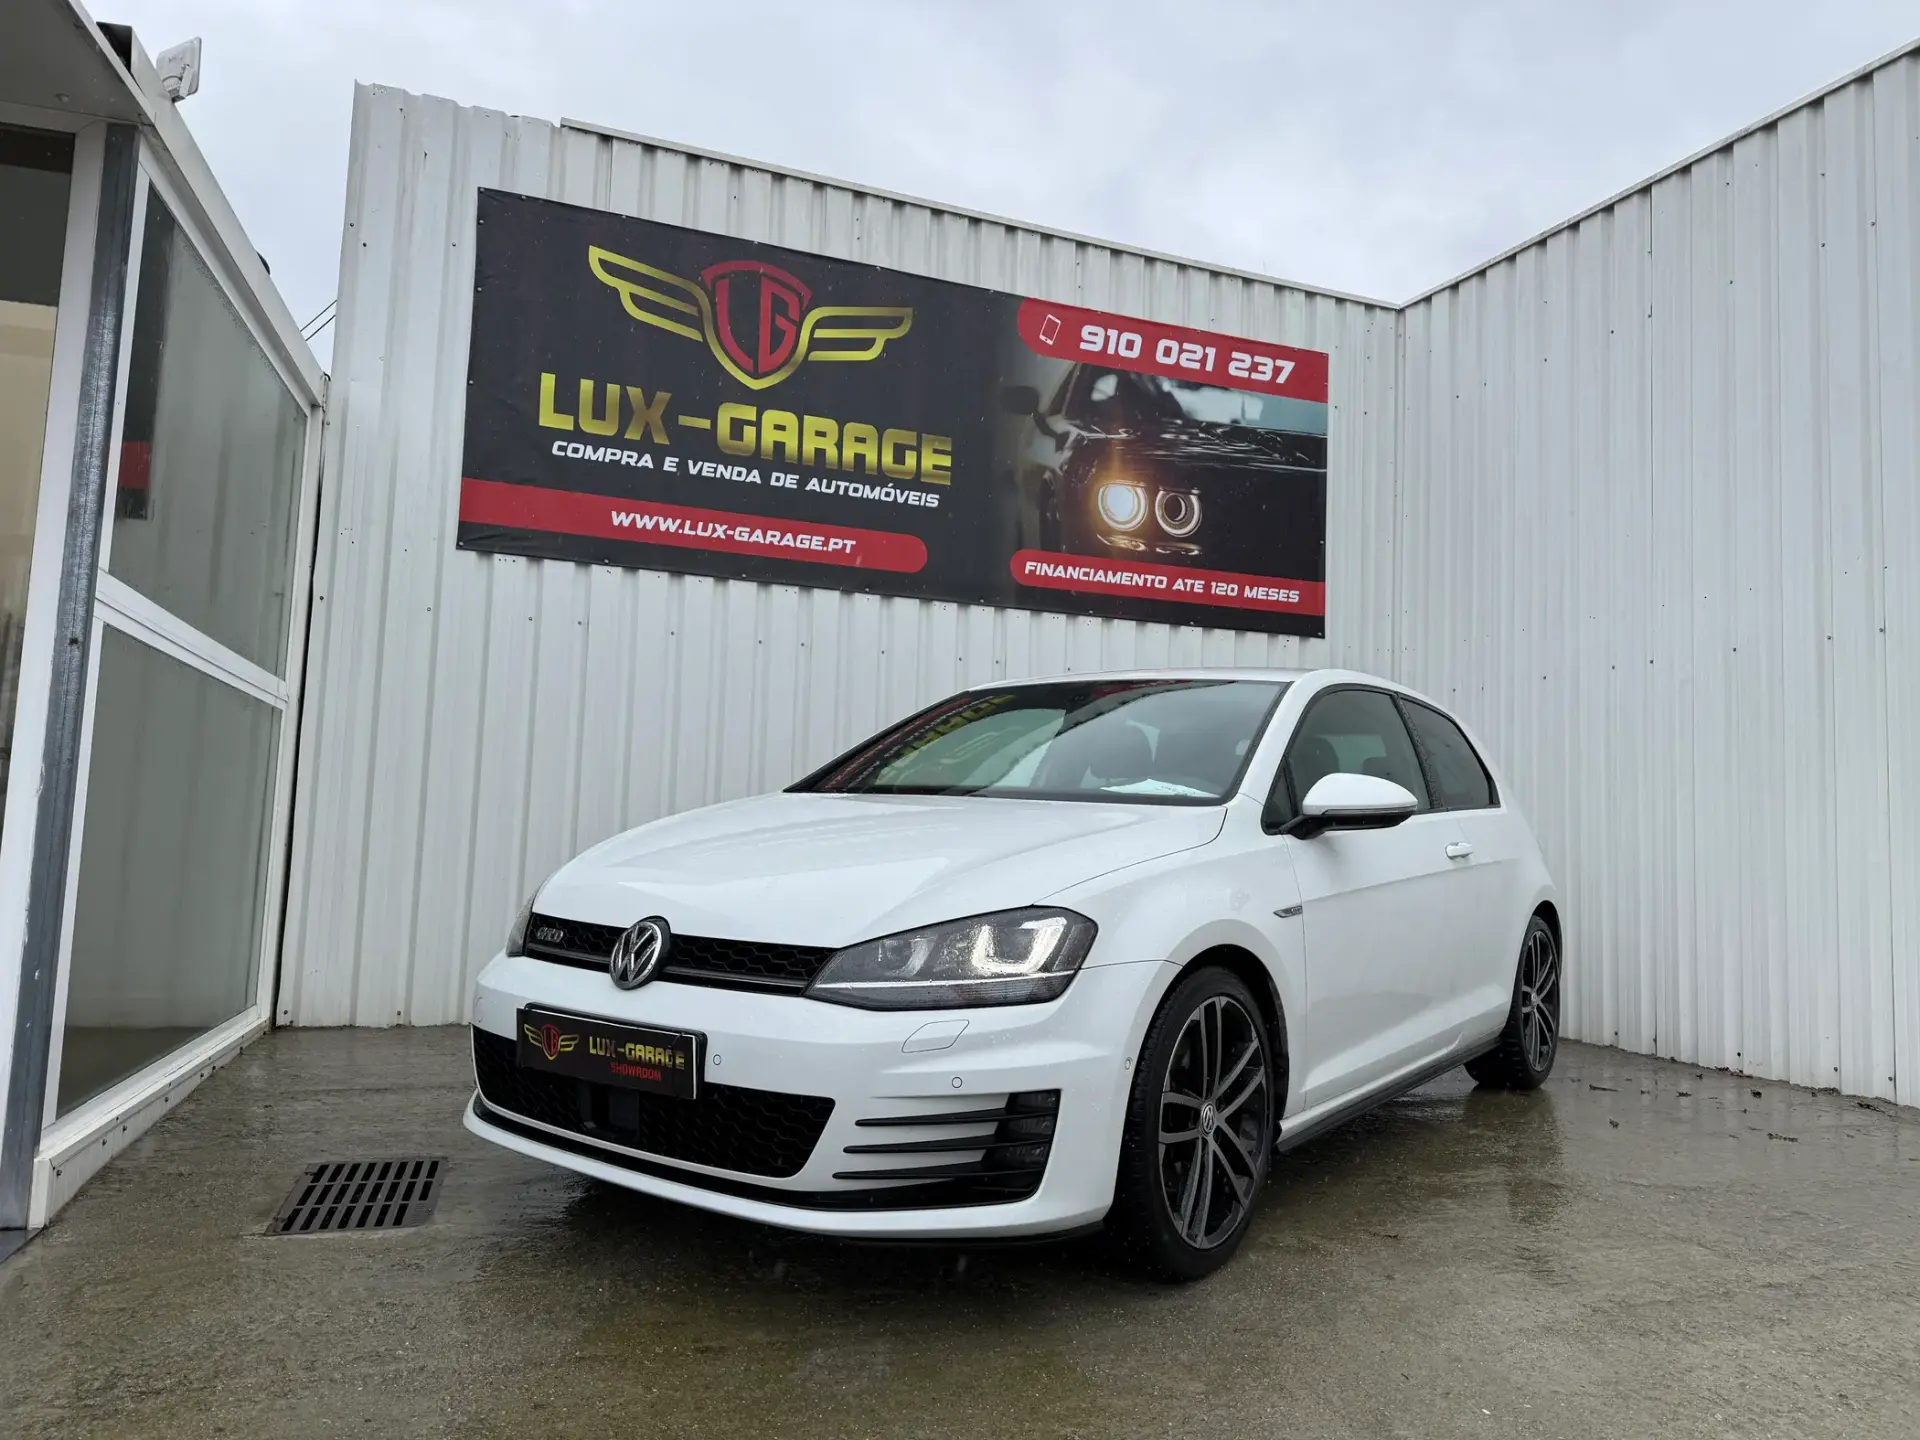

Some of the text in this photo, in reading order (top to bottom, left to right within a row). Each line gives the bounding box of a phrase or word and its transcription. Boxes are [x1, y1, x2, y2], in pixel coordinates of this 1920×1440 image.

[1080, 324, 1296, 384] 910 021 237
[538, 372, 953, 485] LUX-GARAGE
[552, 441, 940, 508] COMPRA E VENDA DE AUTOMÓVEIS
[611, 511, 856, 555] WWW.LUX-GARAGE.PT
[1025, 561, 1300, 603] FINANCIAMENTO ATE 120 MESES
[589, 1036, 685, 1070] LUX-GARAGE
[609, 1062, 662, 1081] SHOWROOM
